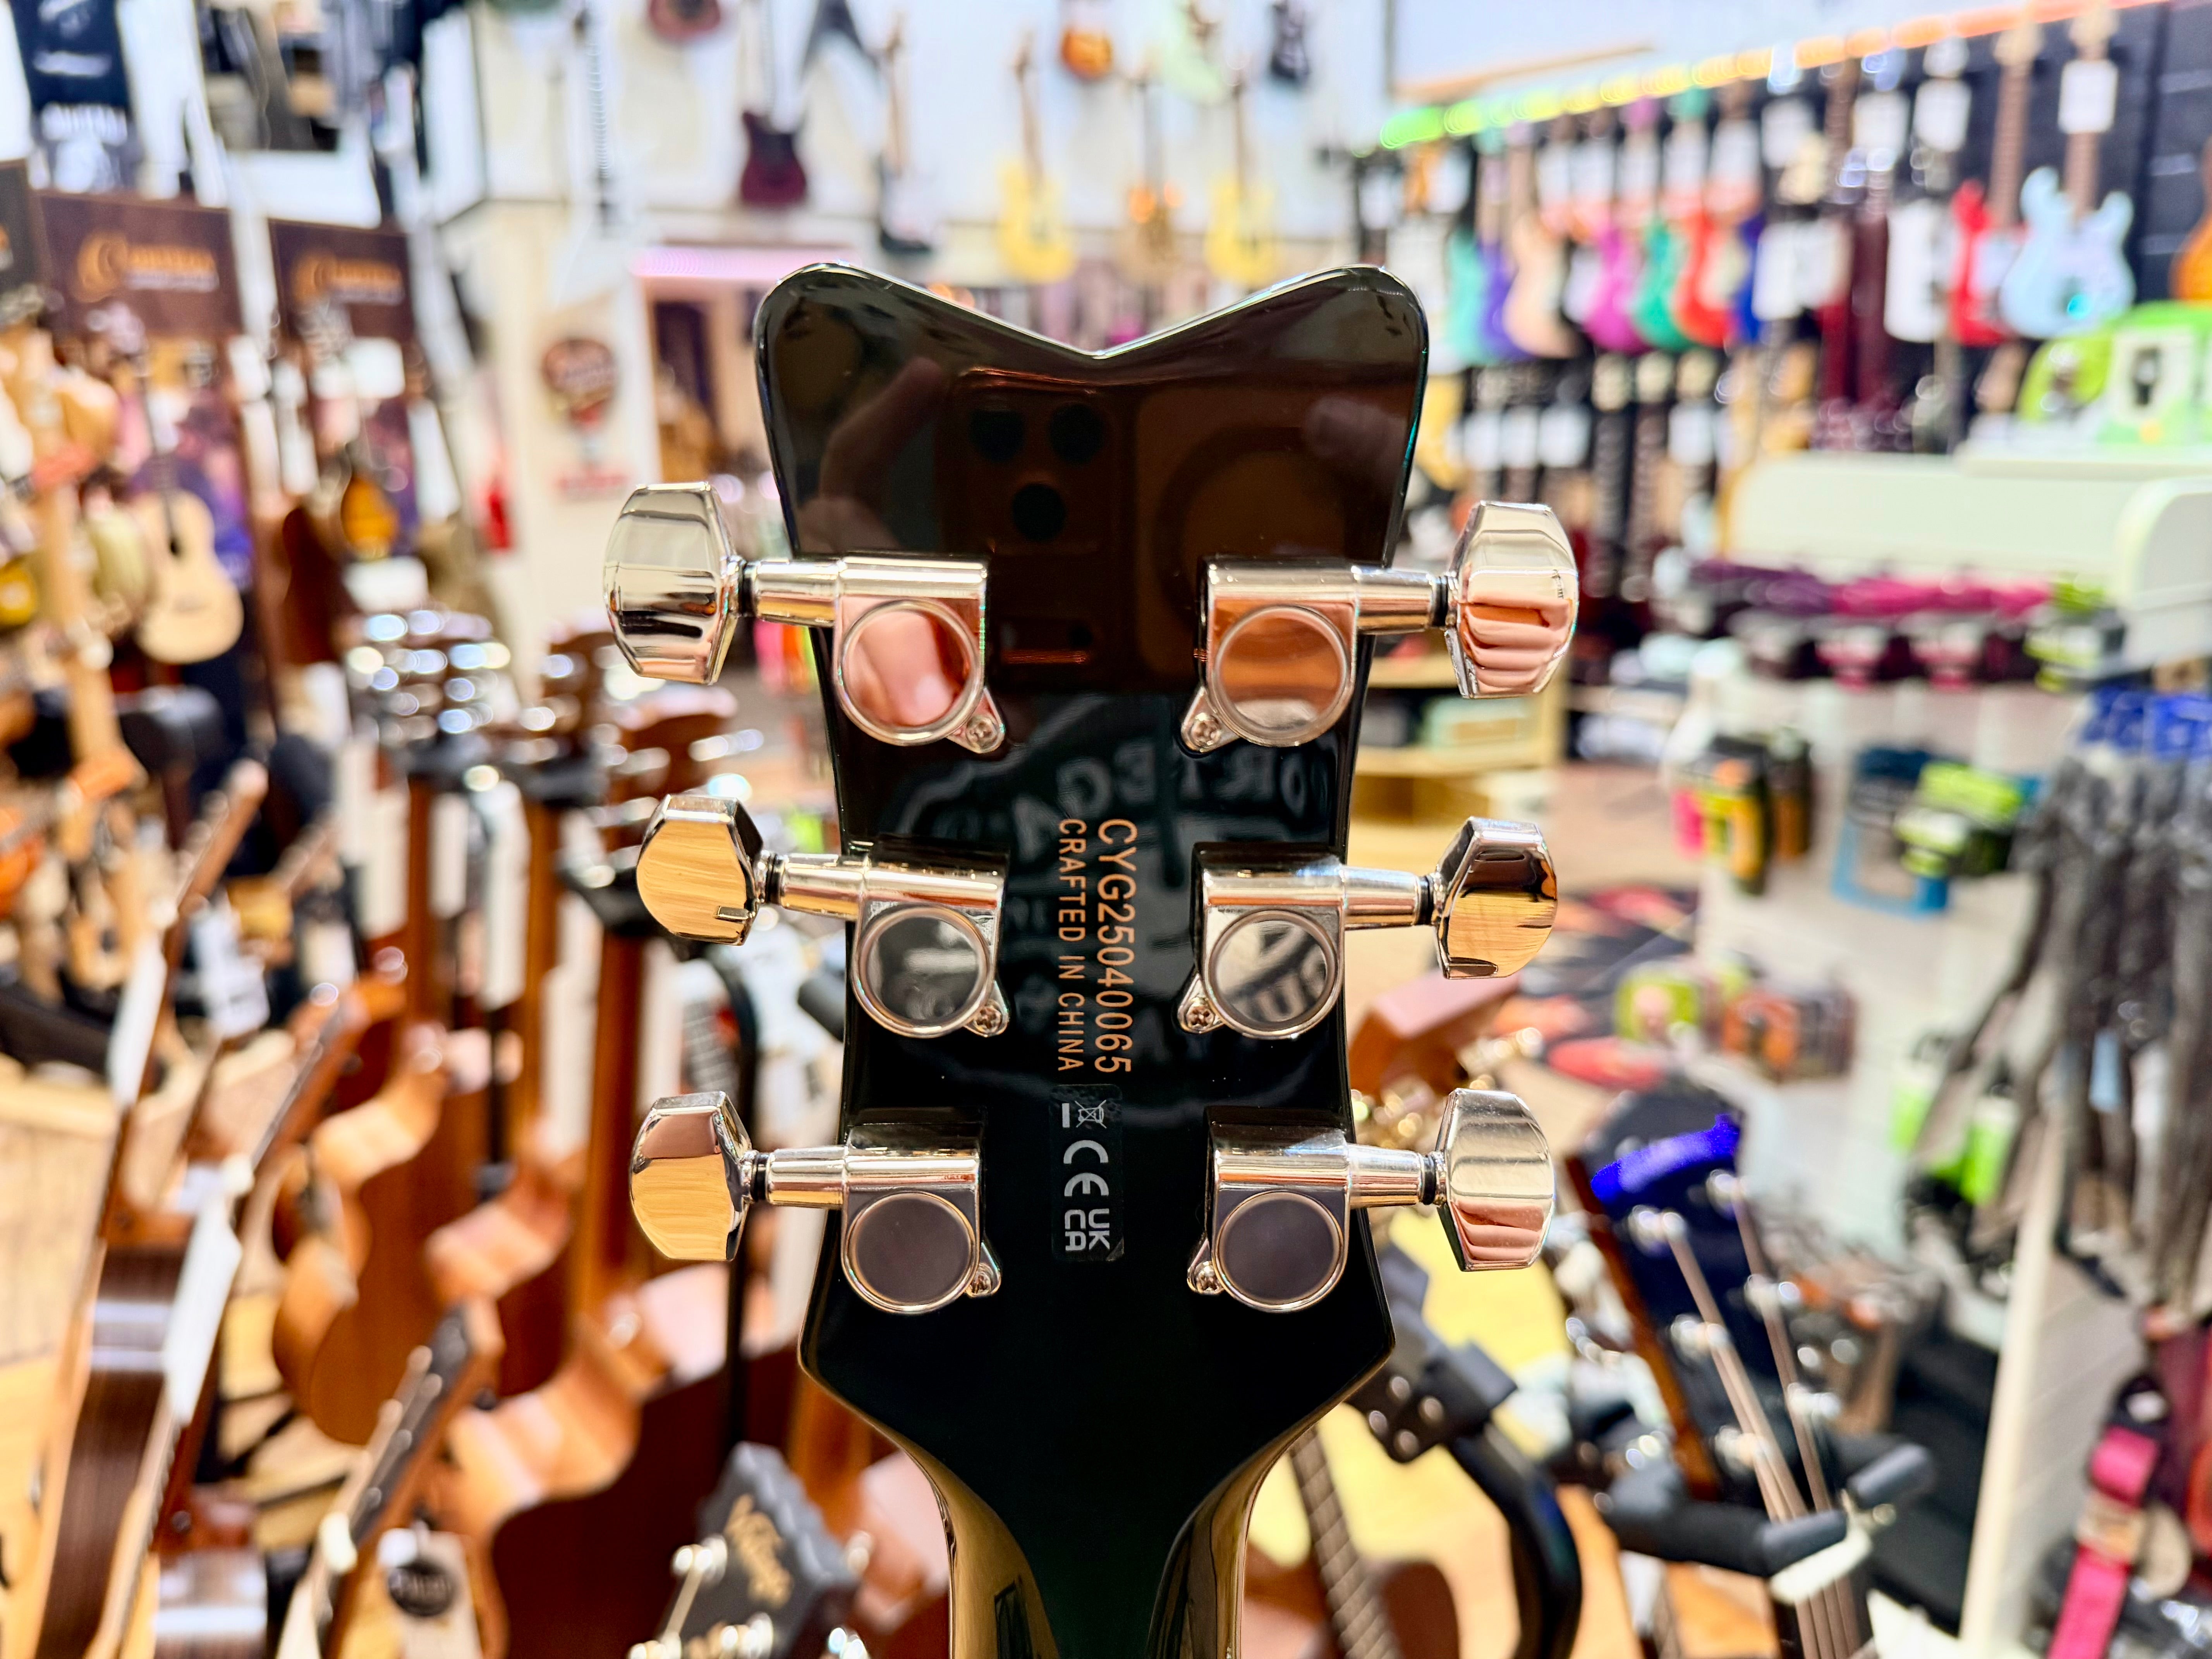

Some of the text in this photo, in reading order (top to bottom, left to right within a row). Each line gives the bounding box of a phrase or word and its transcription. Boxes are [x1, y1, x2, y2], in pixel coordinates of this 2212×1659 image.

[1058, 819, 1087, 1071] CRAFTED IN CHINA
[1094, 819, 1138, 1072] CYG25040065
[1063, 1140, 1109, 1197] CE
[1065, 1209, 1086, 1251] CA
[1089, 1208, 1110, 1250] UK
